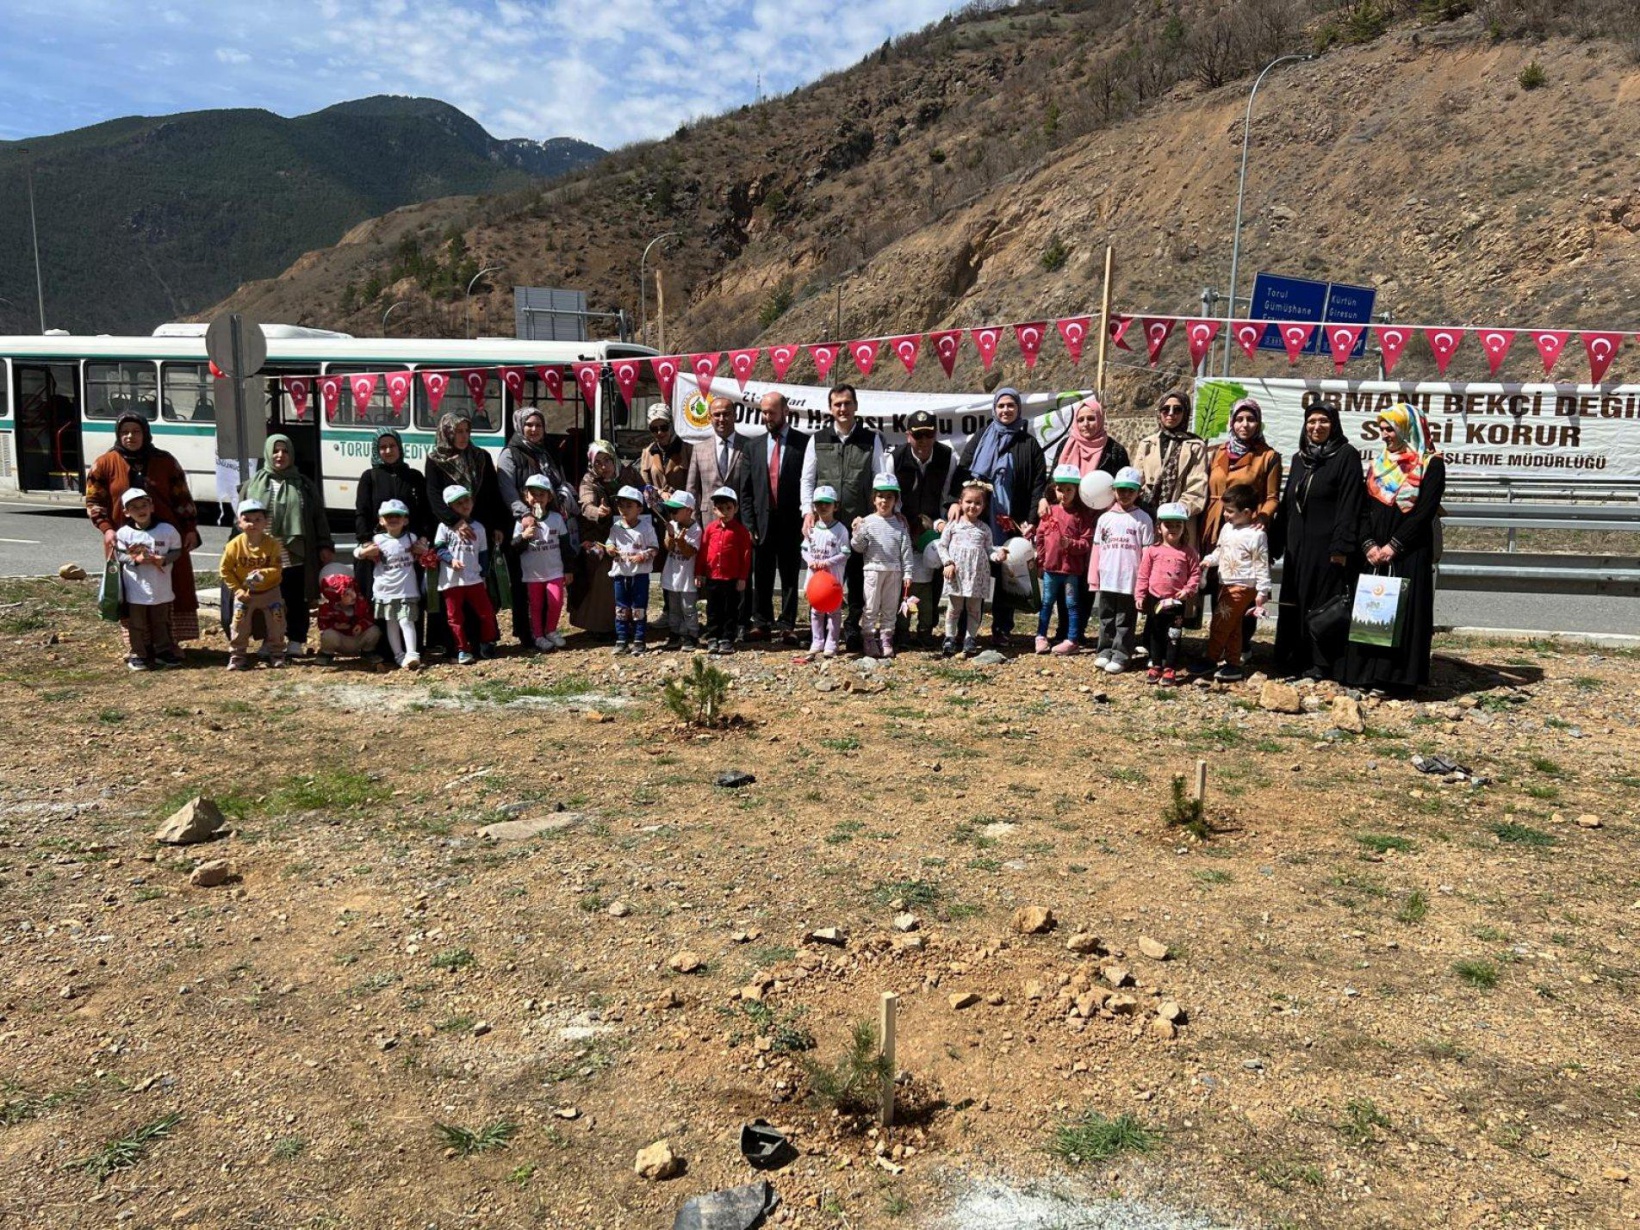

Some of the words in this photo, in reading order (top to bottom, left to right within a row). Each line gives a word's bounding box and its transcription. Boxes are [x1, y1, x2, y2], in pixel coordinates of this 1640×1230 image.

[1267, 287, 1288, 299] Torul
[1331, 295, 1357, 307] Kürtün
[1264, 300, 1312, 316] Gümüşhane
[1329, 308, 1358, 320] Giresun
[1443, 391, 1543, 418] BEKÇİ
[1466, 423, 1581, 447] KORUR
[1508, 453, 1607, 470] MÜDÜRLÜĞÜ
